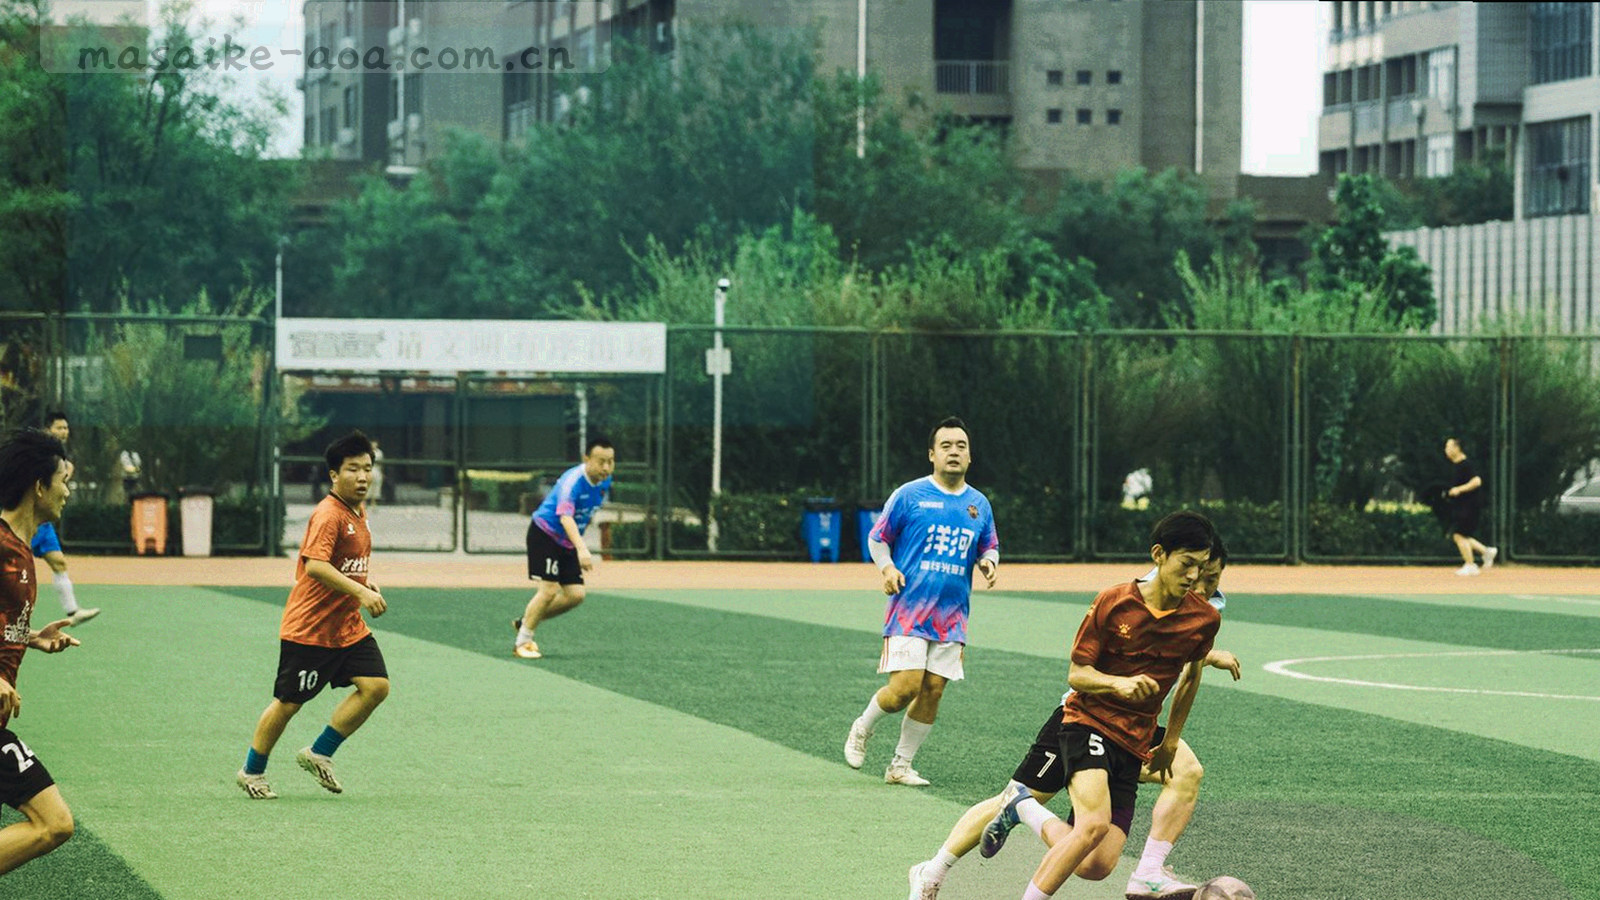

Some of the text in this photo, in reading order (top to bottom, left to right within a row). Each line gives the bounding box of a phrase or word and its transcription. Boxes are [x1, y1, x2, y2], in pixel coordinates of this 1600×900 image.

[924, 524, 974, 559] 洋河
[545, 558, 559, 575] 16
[298, 670, 318, 691] 10
[1088, 734, 1105, 756] 5
[1036, 751, 1056, 778] 7
